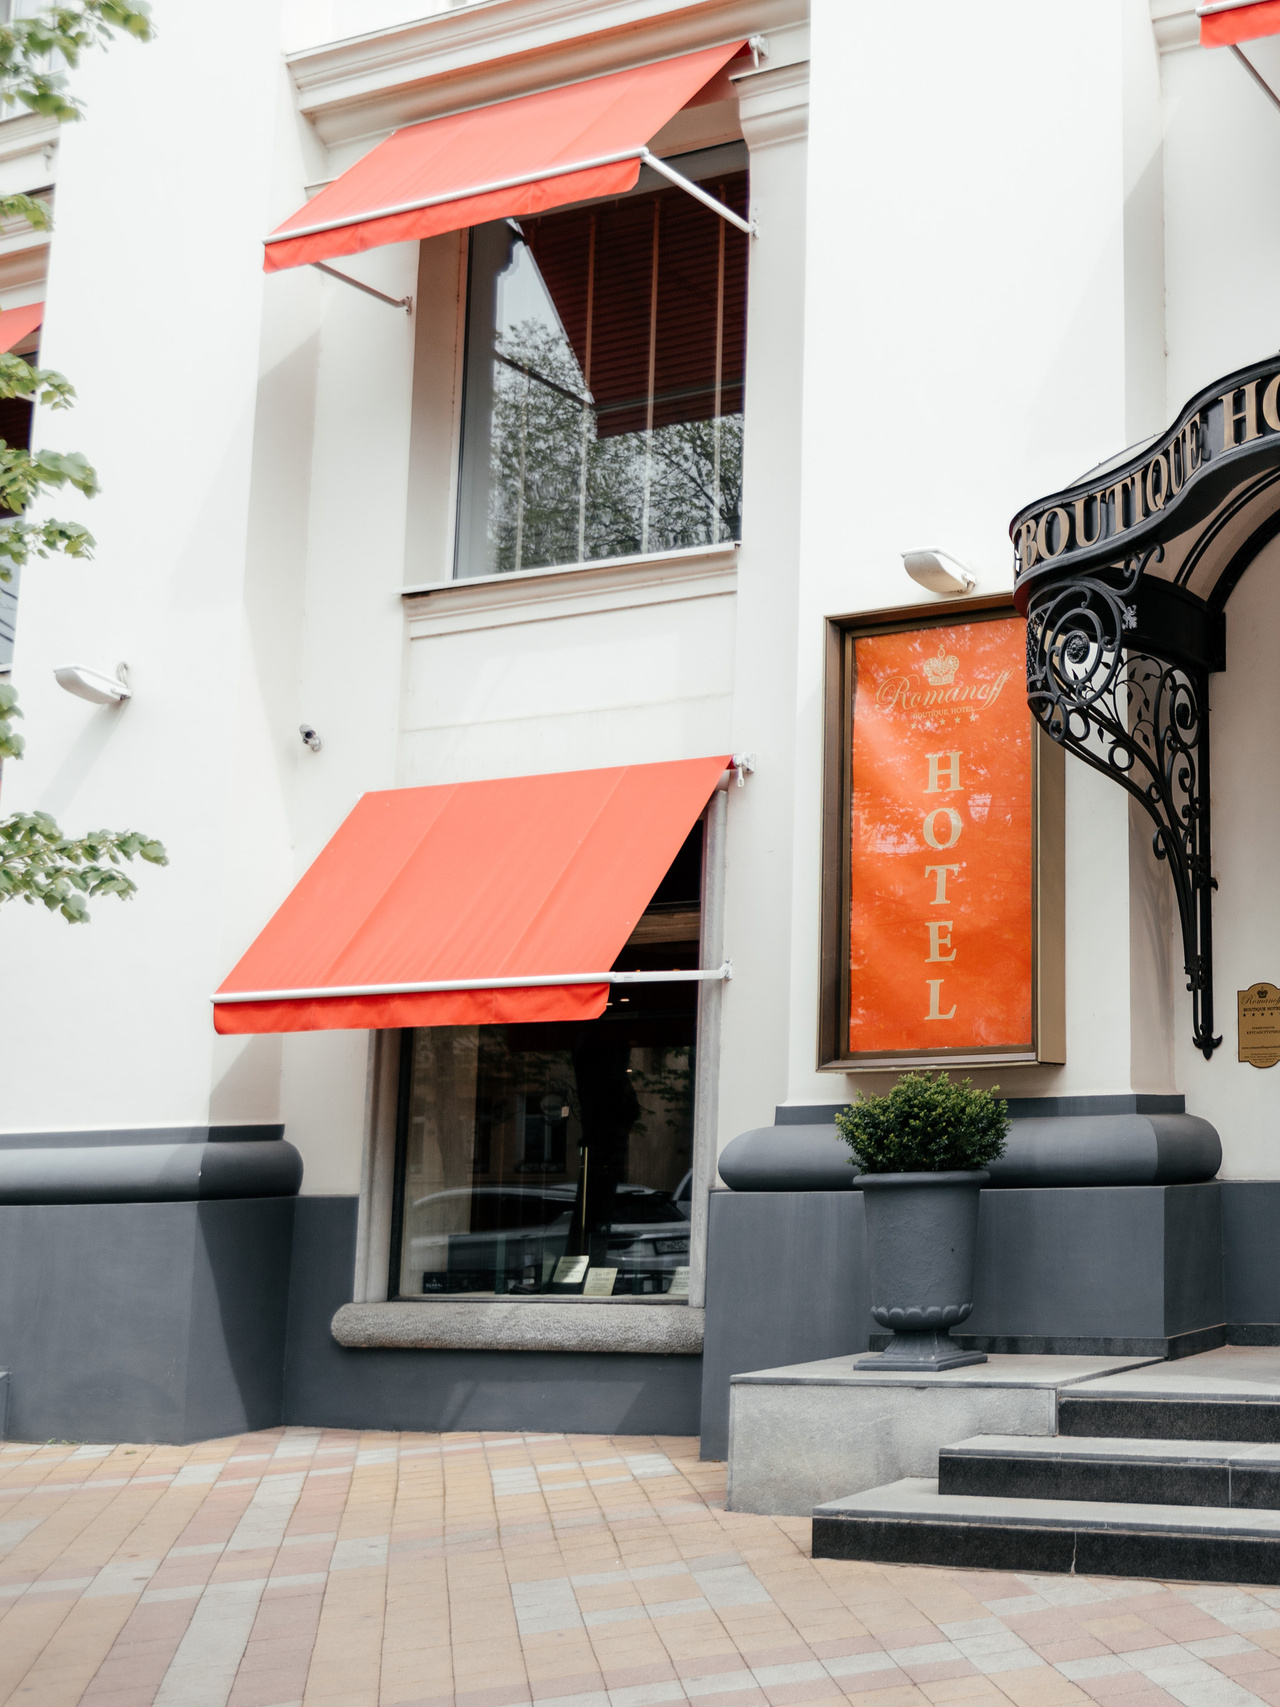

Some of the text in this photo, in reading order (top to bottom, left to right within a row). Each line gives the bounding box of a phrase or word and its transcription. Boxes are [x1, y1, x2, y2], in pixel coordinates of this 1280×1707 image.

[1017, 411, 1202, 574] BOUTIQUE
[874, 667, 1015, 712] Romanoff
[912, 705, 974, 720] BOUTIQUE HOTEL
[922, 750, 965, 1021] HOTEL
